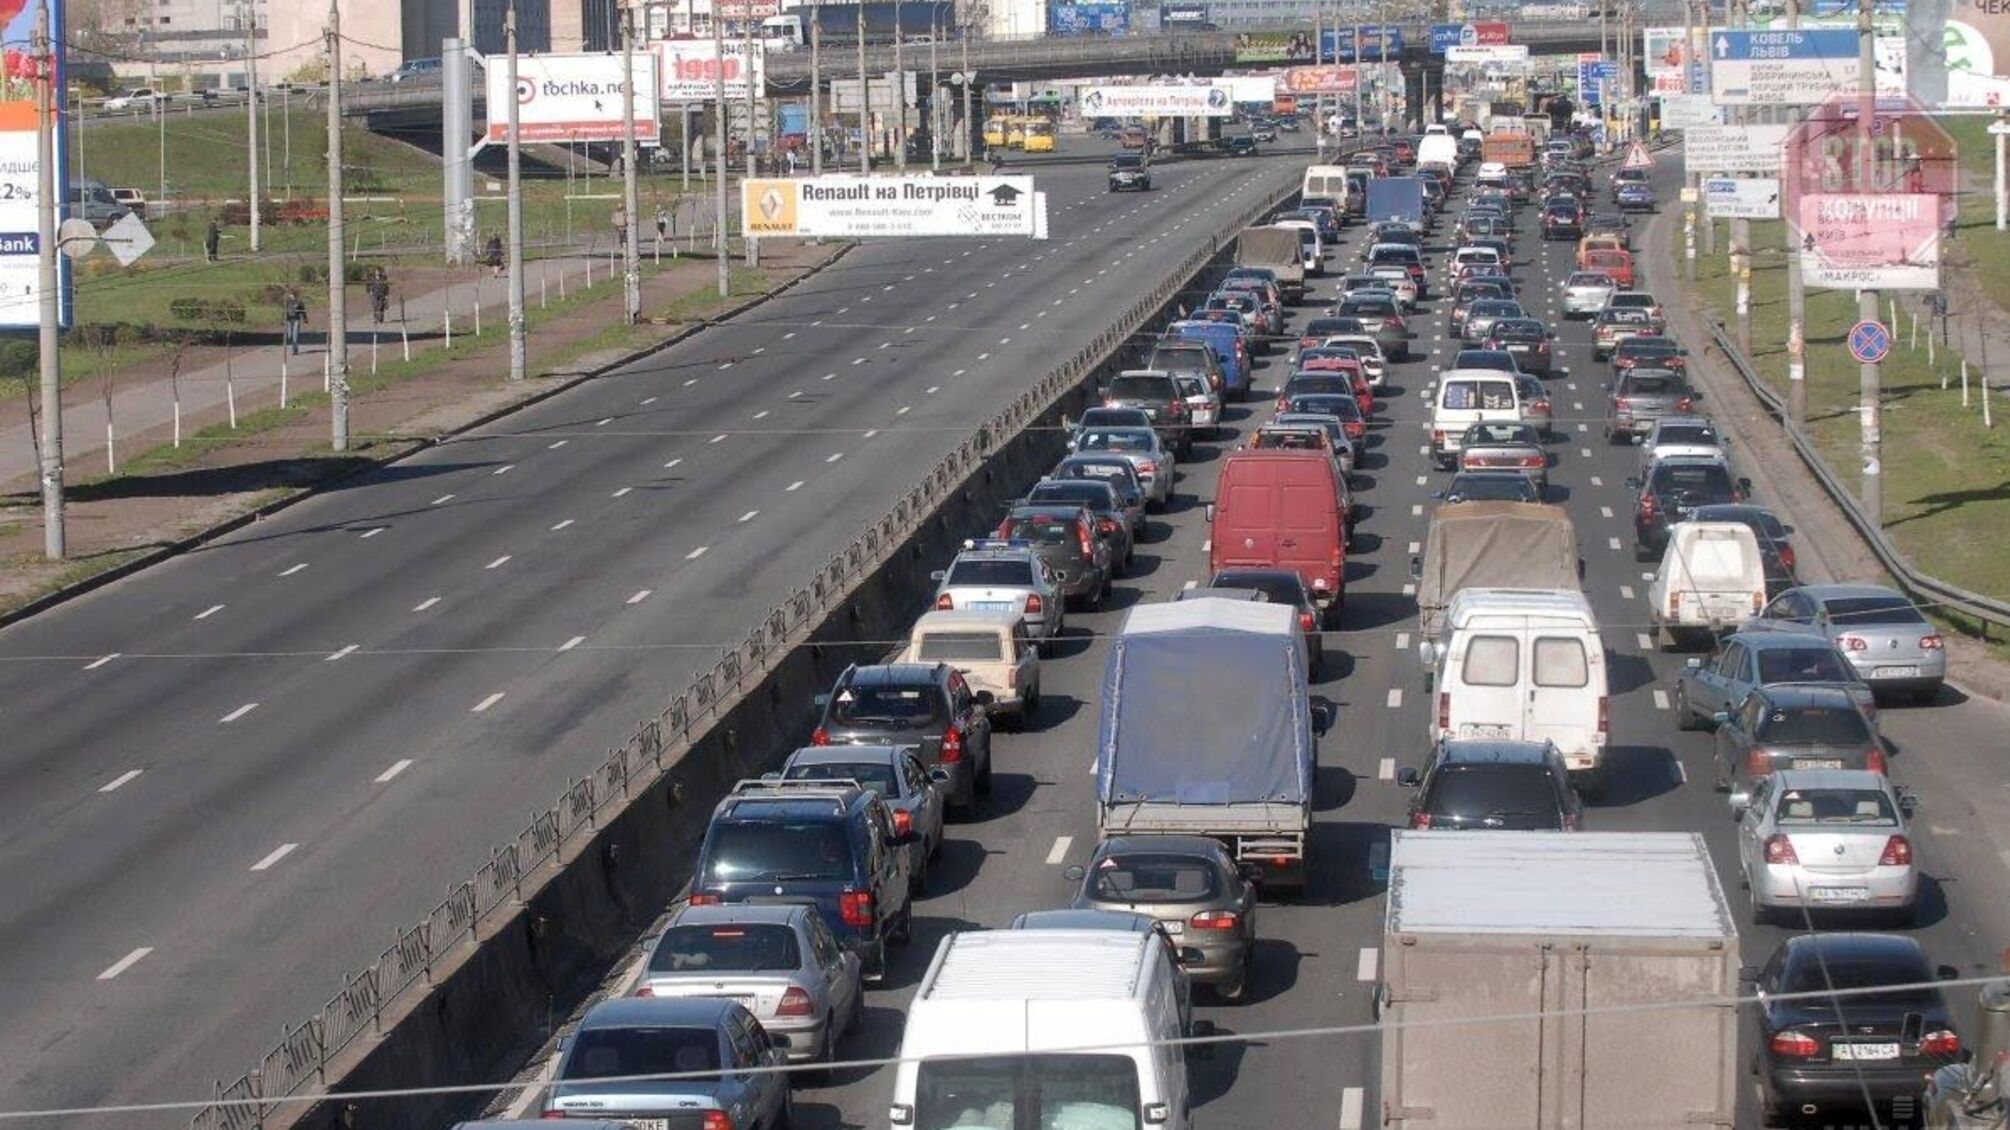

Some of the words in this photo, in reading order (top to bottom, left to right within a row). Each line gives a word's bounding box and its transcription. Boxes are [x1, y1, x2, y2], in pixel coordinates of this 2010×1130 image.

[1750, 33, 1804, 45] КОВЕЛЬ
[1750, 46, 1790, 58] ЛЬВІВ
[542, 80, 634, 98] tochka.ne
[802, 182, 870, 200] Renault
[875, 186, 897, 200] на
[903, 182, 980, 203] Петрівці
[1817, 229, 1846, 242] КИЇВ
